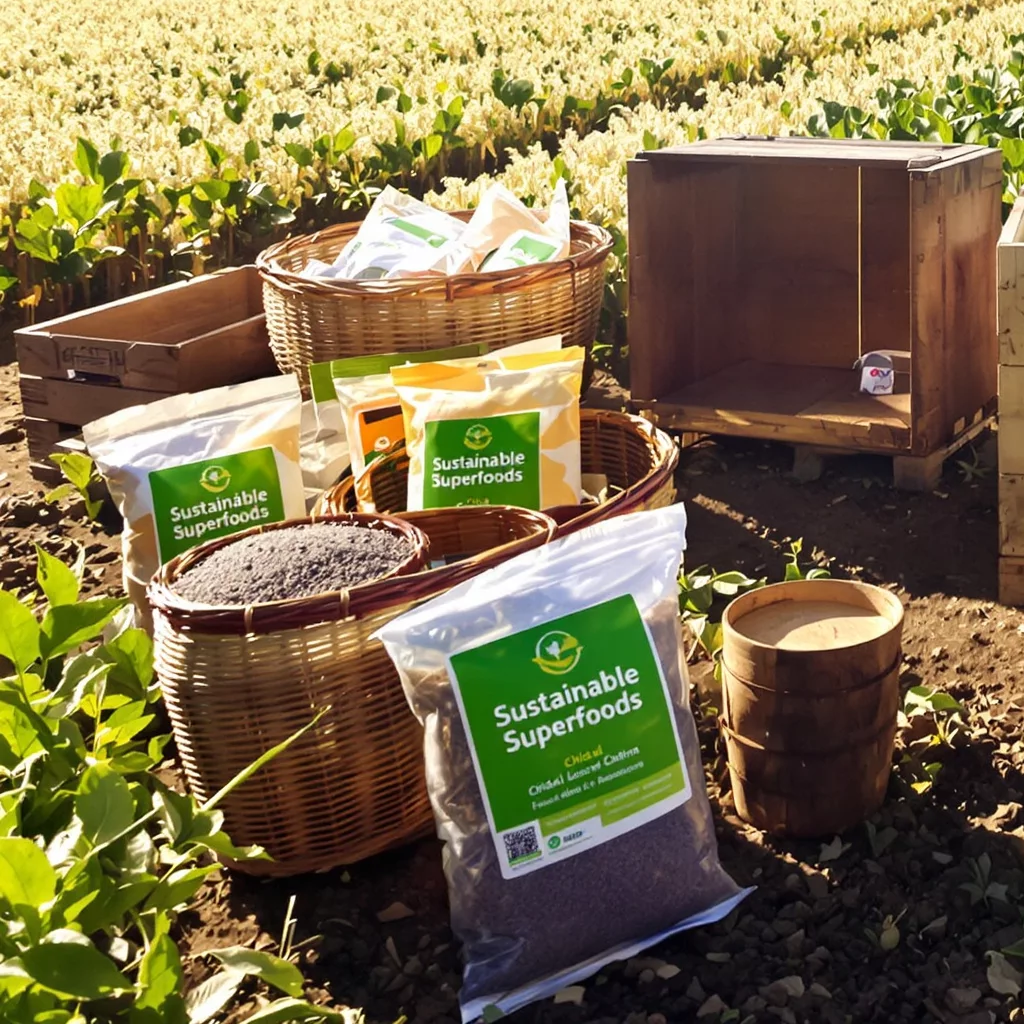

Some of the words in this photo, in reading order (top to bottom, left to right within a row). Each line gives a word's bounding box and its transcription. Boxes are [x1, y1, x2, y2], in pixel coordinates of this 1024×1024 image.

[431, 468, 523, 489] Superfoods
[432, 451, 525, 472] Sustainable
[170, 489, 268, 522] Sustainable
[173, 505, 269, 540] Superfoods
[494, 666, 640, 727] Sustainable
[503, 691, 643, 753] Superfoods
